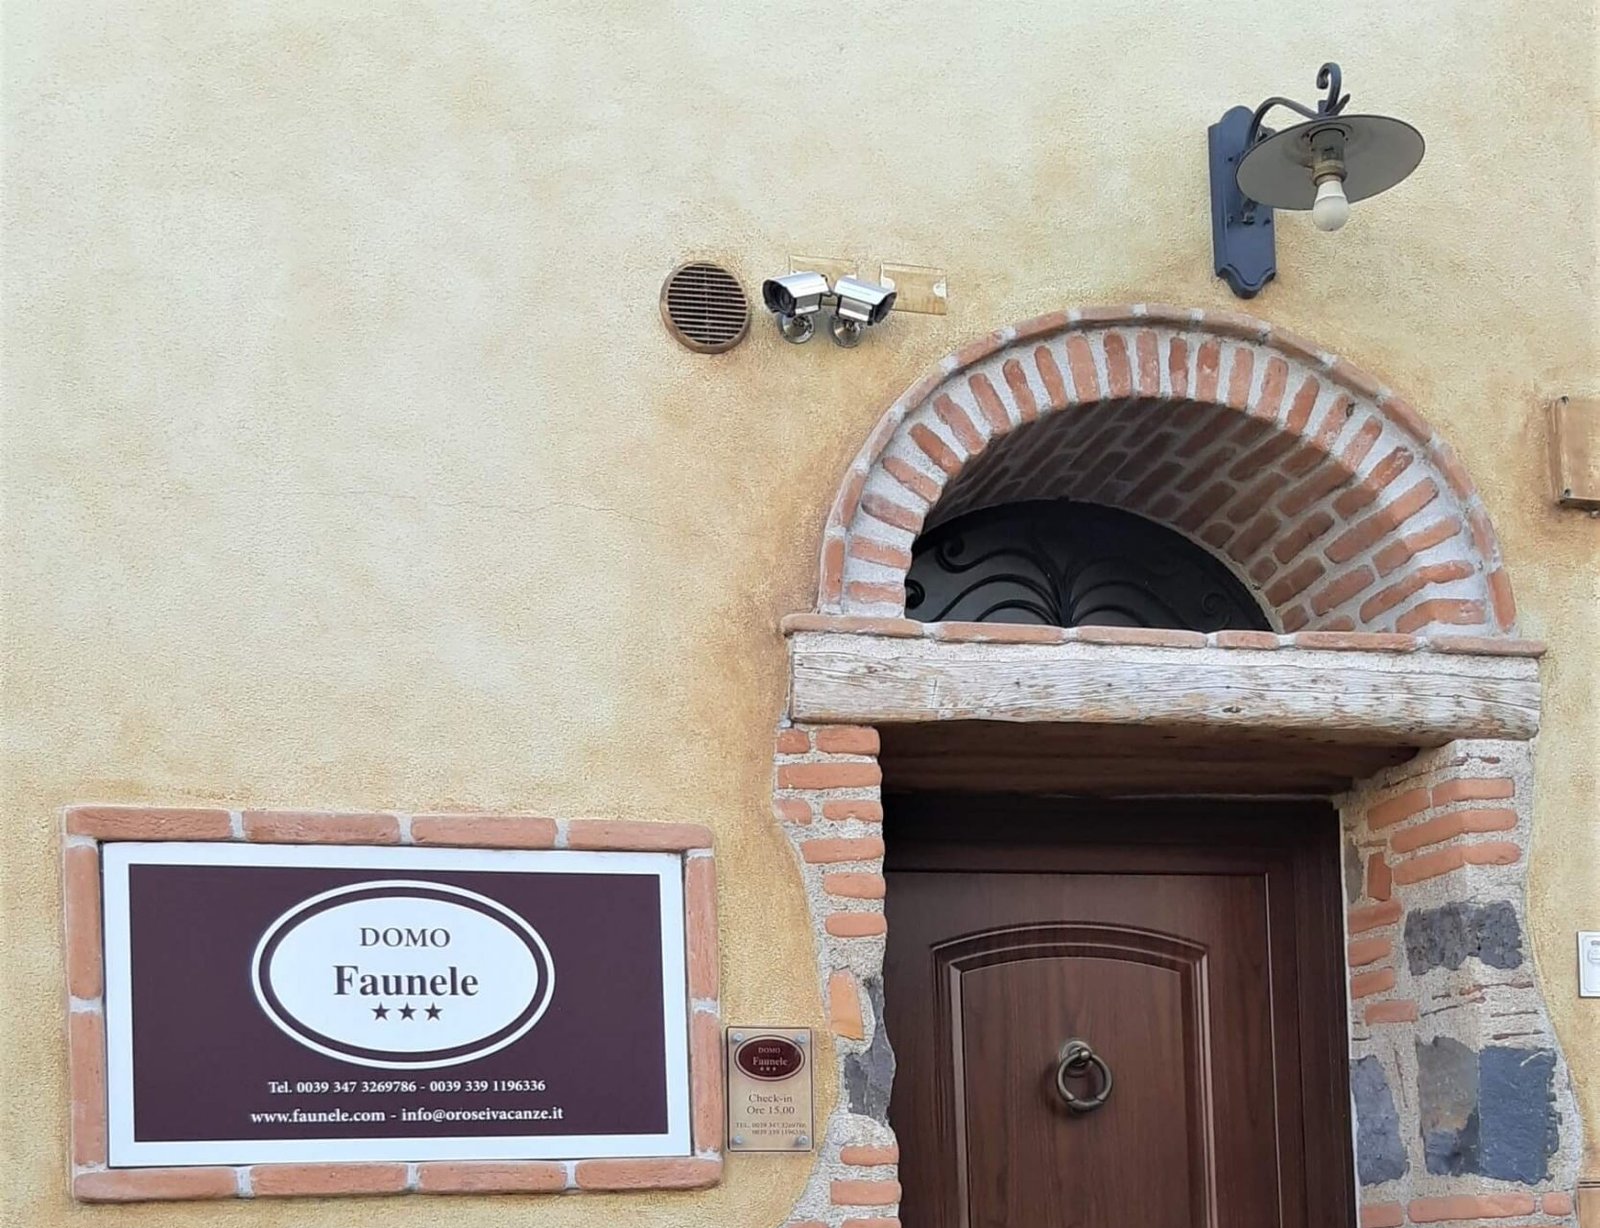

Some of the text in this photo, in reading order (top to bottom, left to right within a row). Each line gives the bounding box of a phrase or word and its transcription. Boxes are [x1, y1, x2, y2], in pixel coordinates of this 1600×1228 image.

[359, 927, 451, 948] DOMO
[332, 965, 479, 996] Faunele
[267, 1081, 293, 1094] Tel.
[296, 1081, 329, 1094] 0039
[333, 1081, 357, 1093] 347
[361, 1080, 417, 1093] 3269786
[430, 1080, 462, 1092] 0039
[465, 1080, 489, 1092] 339
[493, 1080, 546, 1092] 1196336
[748, 1093, 793, 1103] Check-in
[250, 1108, 386, 1123] www.faunele.com
[401, 1106, 564, 1123] info@oroseivacanze.it
[746, 1105, 765, 1114] Ore
